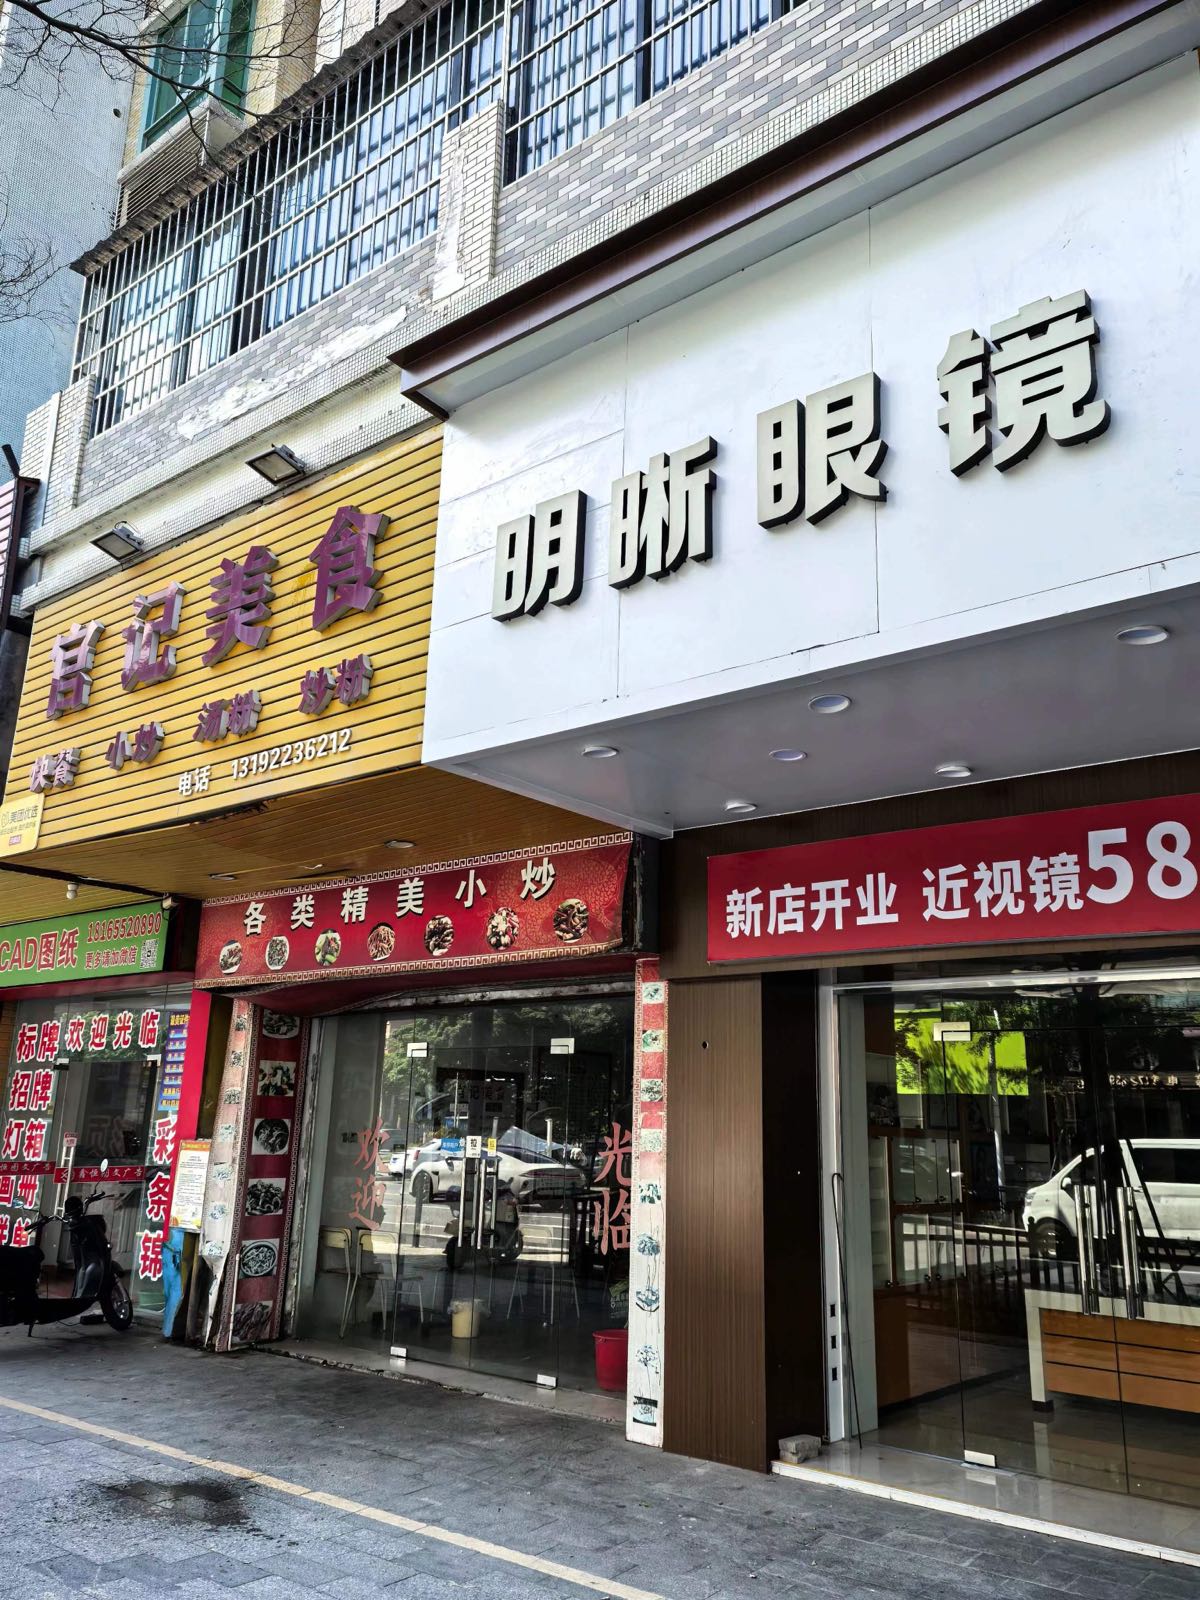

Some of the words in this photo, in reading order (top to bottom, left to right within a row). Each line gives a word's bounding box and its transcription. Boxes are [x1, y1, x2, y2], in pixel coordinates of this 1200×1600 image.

[491, 289, 1111, 622] 明晰眼镜
[105, 721, 165, 770] 小炒
[192, 690, 263, 742] 汤粉
[299, 654, 374, 716] 炒粉
[178, 764, 211, 796] 电话
[231, 728, 352, 781] 13192236212
[243, 857, 556, 936] 各类精美小炒
[726, 872, 899, 939] 新店开业
[0, 928, 79, 973] CAD图纸
[87, 912, 162, 943] 18165520890
[85, 946, 138, 970] 更多请加微信
[16, 1021, 61, 1063] 标牌
[66, 1009, 161, 1052] 欢迎光临
[9, 1069, 55, 1111] 招牌
[1, 1118, 47, 1161] 灯箱
[348, 1116, 390, 1231] 欢迎
[592, 1121, 632, 1255] 光临
